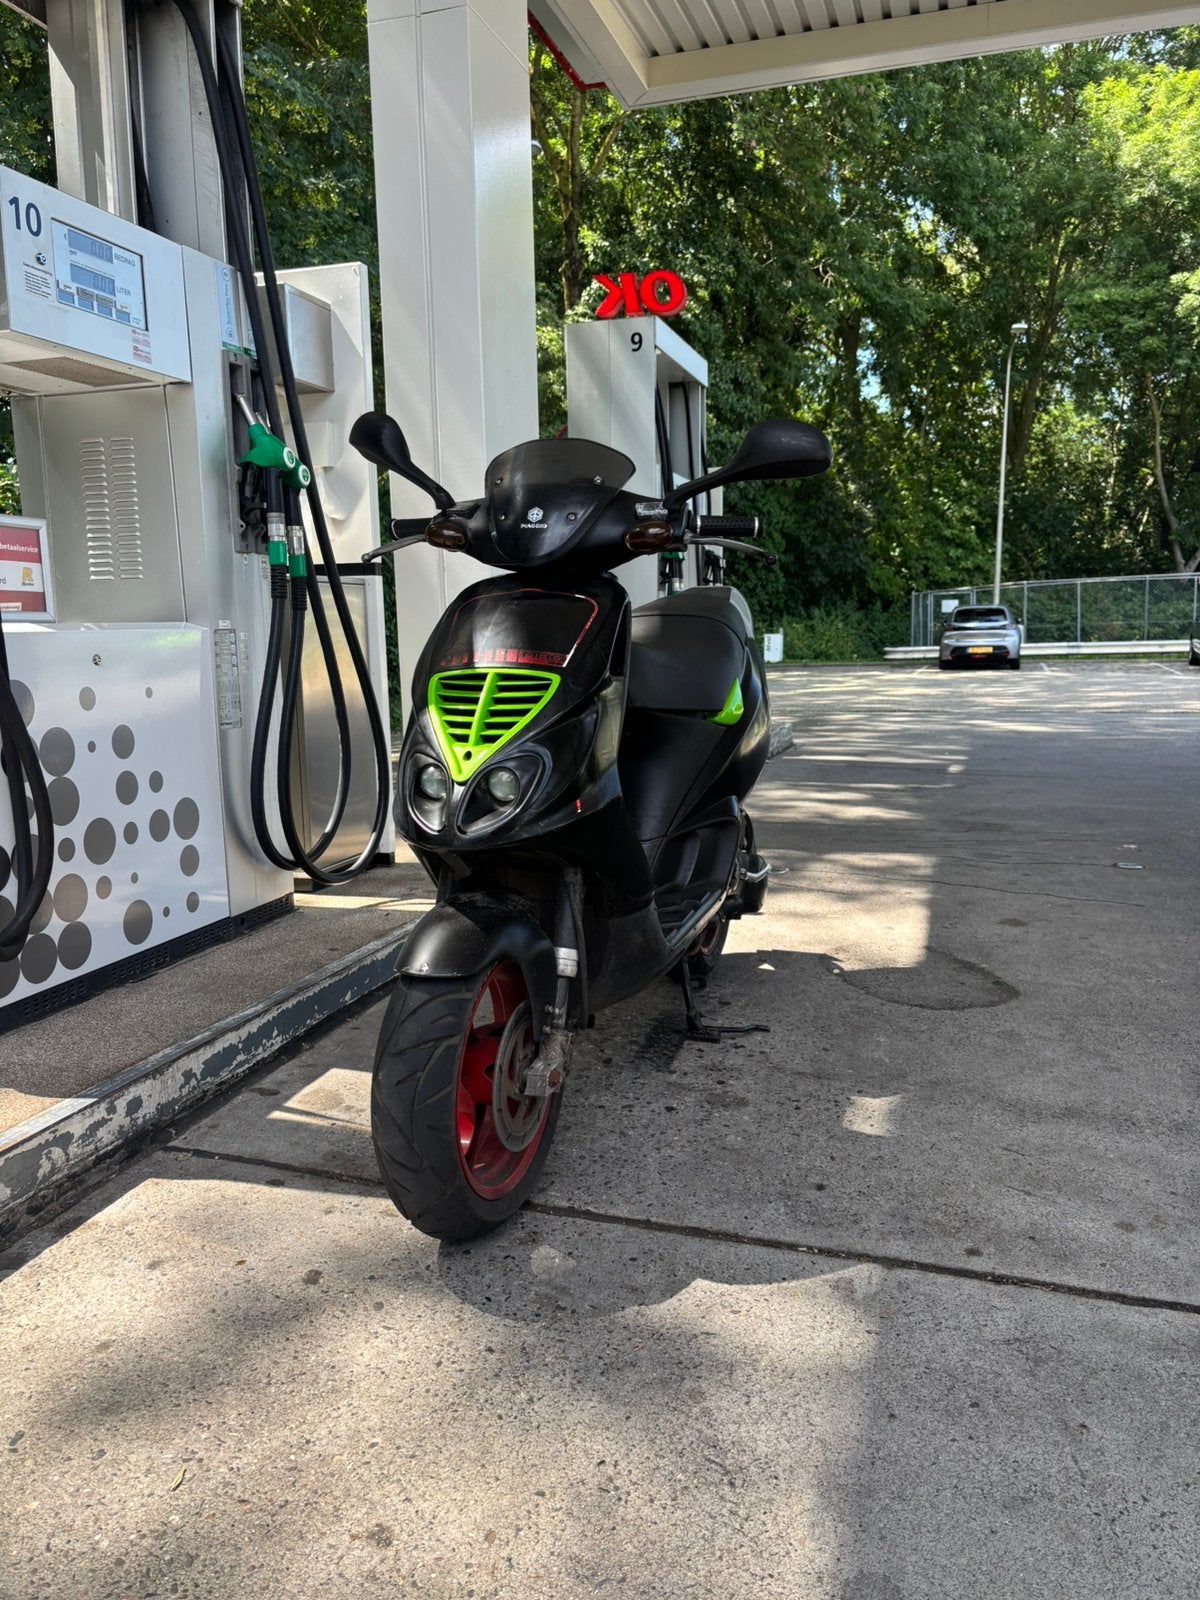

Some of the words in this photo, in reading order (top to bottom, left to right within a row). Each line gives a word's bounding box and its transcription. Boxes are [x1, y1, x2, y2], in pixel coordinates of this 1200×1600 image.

[9, 196, 42, 237] 10
[116, 286, 132, 297] LITER
[630, 332, 643, 352] 9
[0, 541, 39, 554] betaalservice
